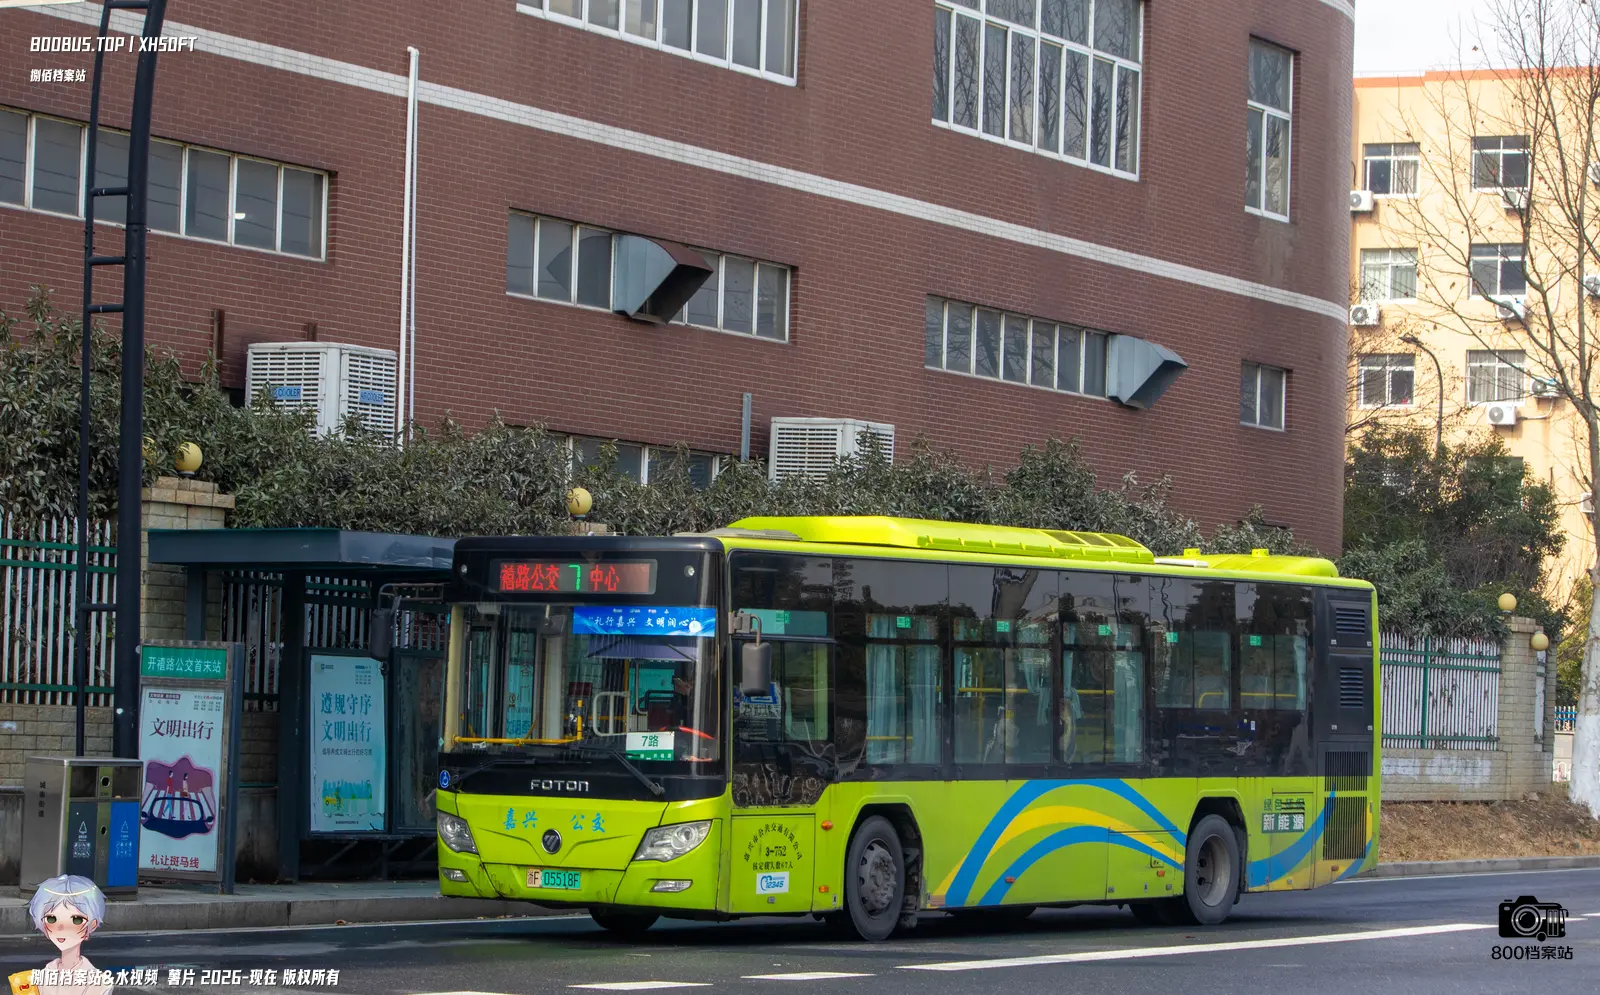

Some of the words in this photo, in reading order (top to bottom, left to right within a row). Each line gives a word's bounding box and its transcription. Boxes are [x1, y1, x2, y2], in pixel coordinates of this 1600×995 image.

[568, 564, 581, 591] 7
[590, 564, 620, 592] 中心
[148, 656, 222, 673] 开禧路公交首末站
[321, 692, 372, 715] 遵规守序
[149, 717, 214, 740] 文明出行
[321, 720, 372, 742] 文明出行
[641, 734, 659, 747] 7路
[530, 780, 589, 792] FOTON
[503, 807, 538, 830] 嘉兴
[570, 812, 605, 832] 公交
[1263, 814, 1304, 831] 新能源
[765, 845, 787, 857] 3-752
[150, 854, 199, 868] 礼让斑马线
[543, 871, 580, 887] 05518F
[765, 880, 784, 889] 12345
